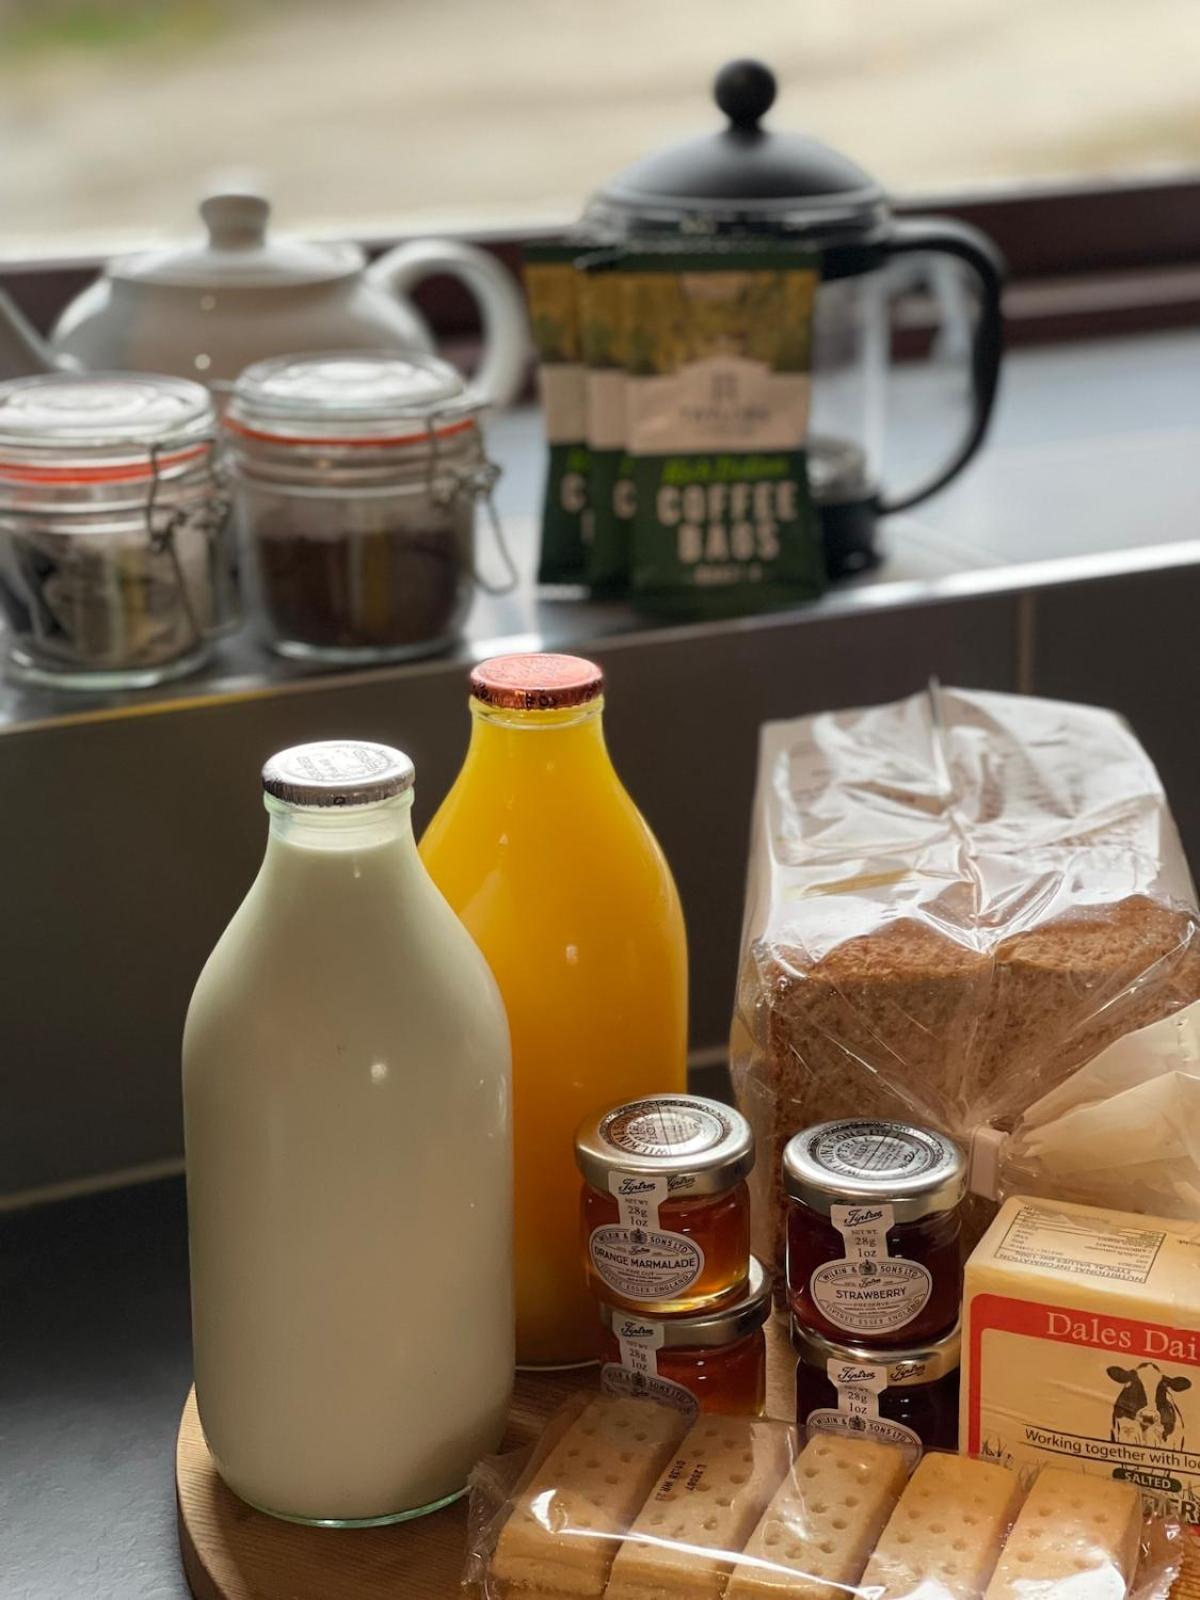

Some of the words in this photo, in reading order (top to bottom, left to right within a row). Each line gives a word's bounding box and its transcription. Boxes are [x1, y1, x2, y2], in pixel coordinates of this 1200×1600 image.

[656, 480, 798, 527] COFFEE
[677, 520, 780, 564] BAGS
[628, 1206, 647, 1218] 28g
[844, 1209, 884, 1227] Tiptree
[630, 1216, 648, 1227] 1oz
[855, 1238, 876, 1248] 28g
[594, 1246, 629, 1266] ORANGE
[631, 1258, 696, 1269] MARMALADE
[858, 1248, 878, 1258] 1oz
[880, 1266, 902, 1274] SONS
[836, 1288, 907, 1300] STRAWBERRY
[1046, 1311, 1132, 1348] Dales
[838, 1366, 876, 1383] Tiptree
[847, 1391, 867, 1404] 28g
[849, 1403, 868, 1415] 1oz
[869, 1424, 891, 1435] SONS
[1025, 1428, 1082, 1454] Working
[1085, 1442, 1146, 1462] together
[1149, 1452, 1181, 1467] with
[1124, 1472, 1171, 1489] SALTED
